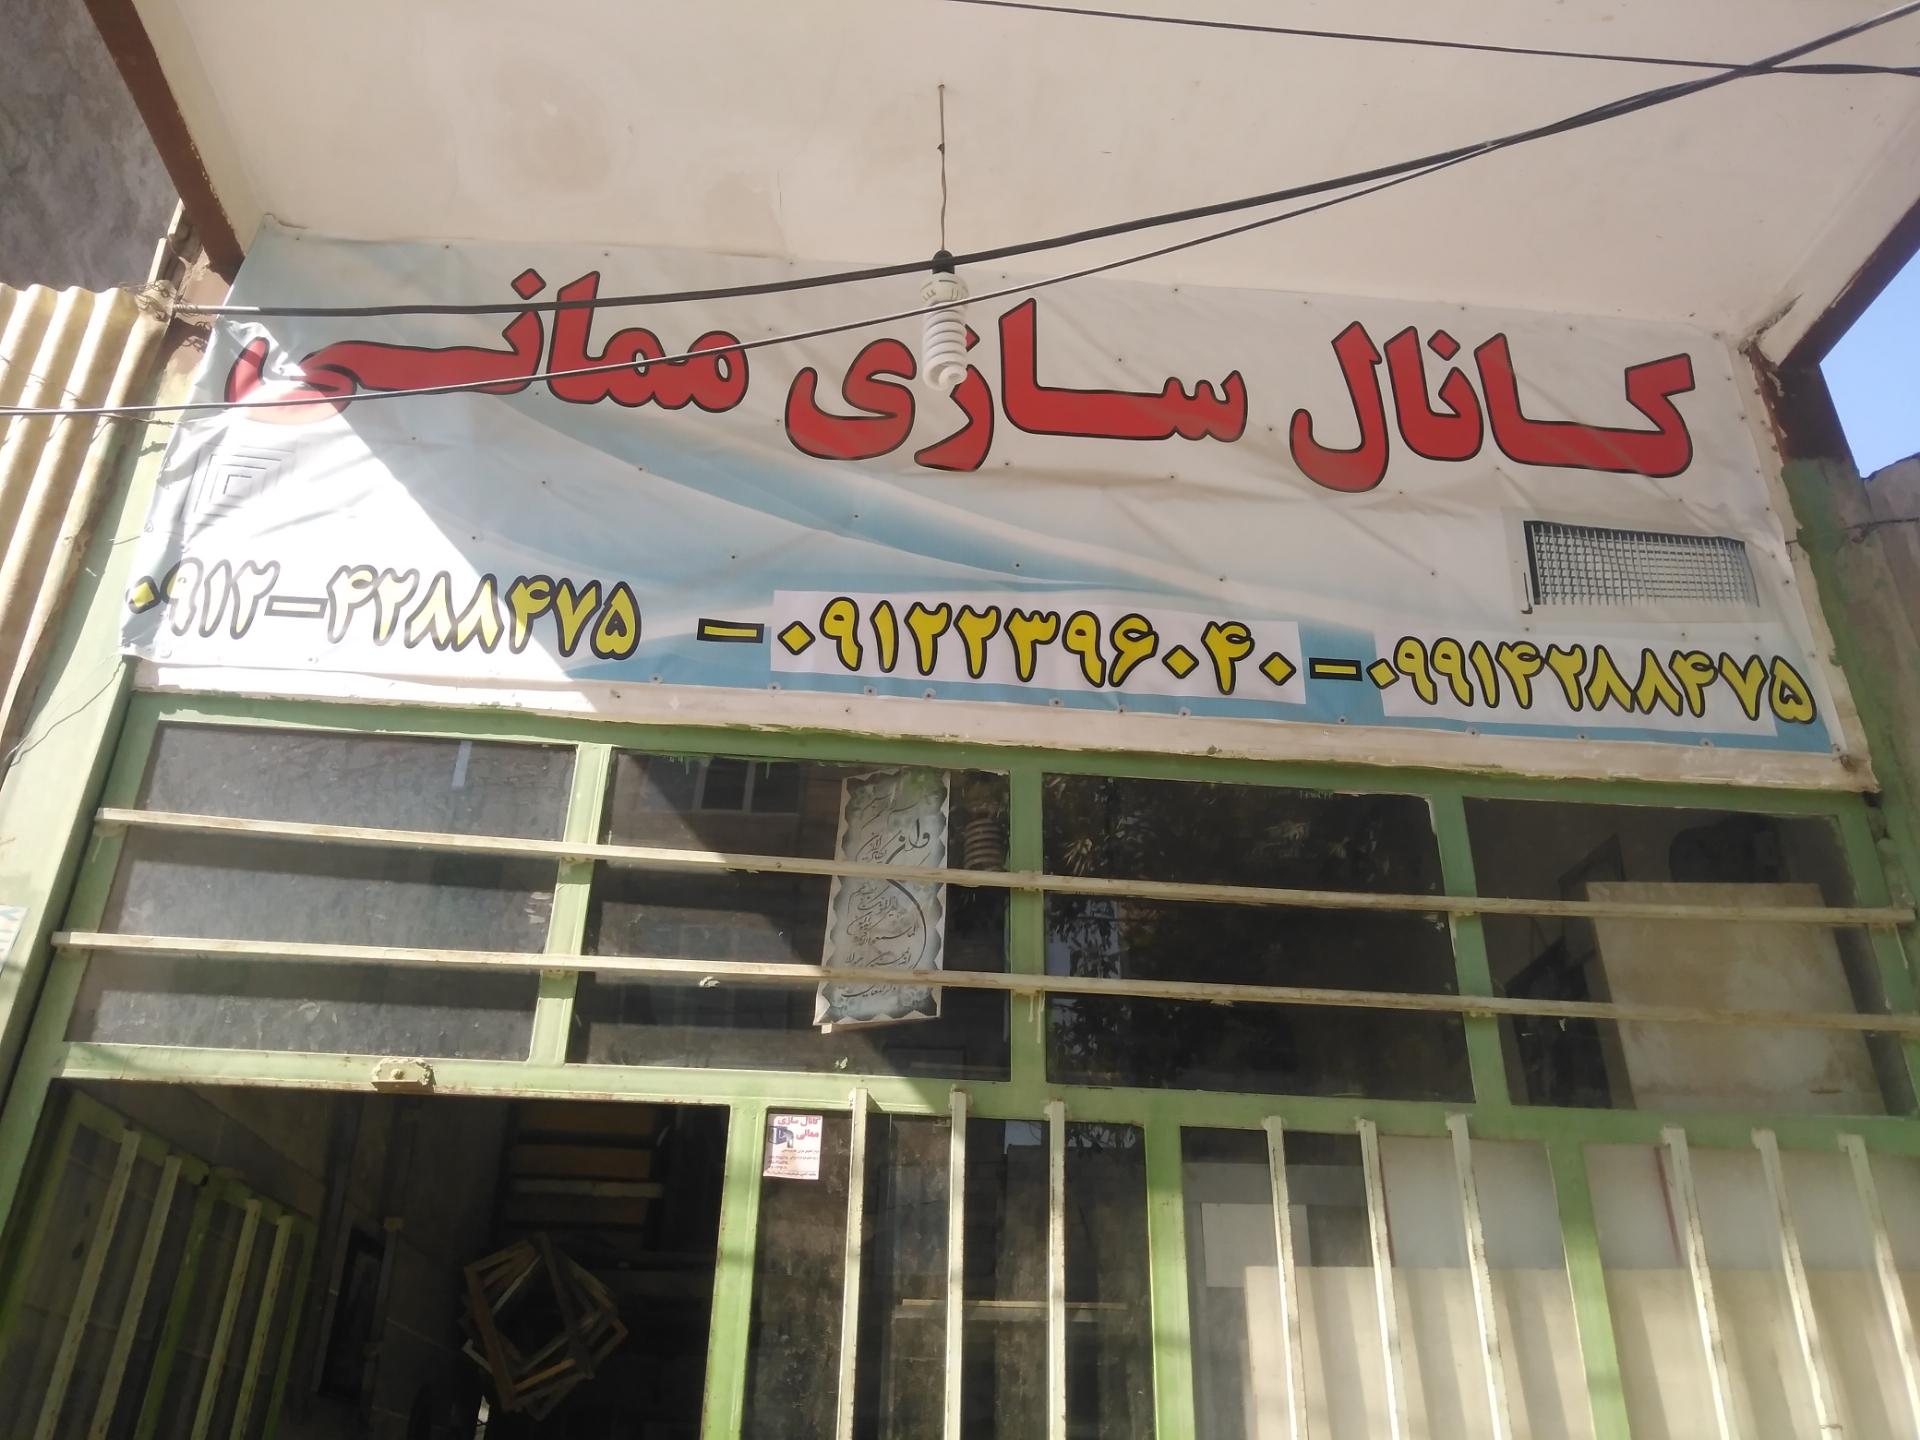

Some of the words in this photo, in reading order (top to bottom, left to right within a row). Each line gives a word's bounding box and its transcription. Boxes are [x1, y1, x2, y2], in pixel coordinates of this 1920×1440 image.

[227, 268, 748, 422] ممانی
[785, 297, 1249, 472] سازی
[1290, 320, 1694, 493] کانال
